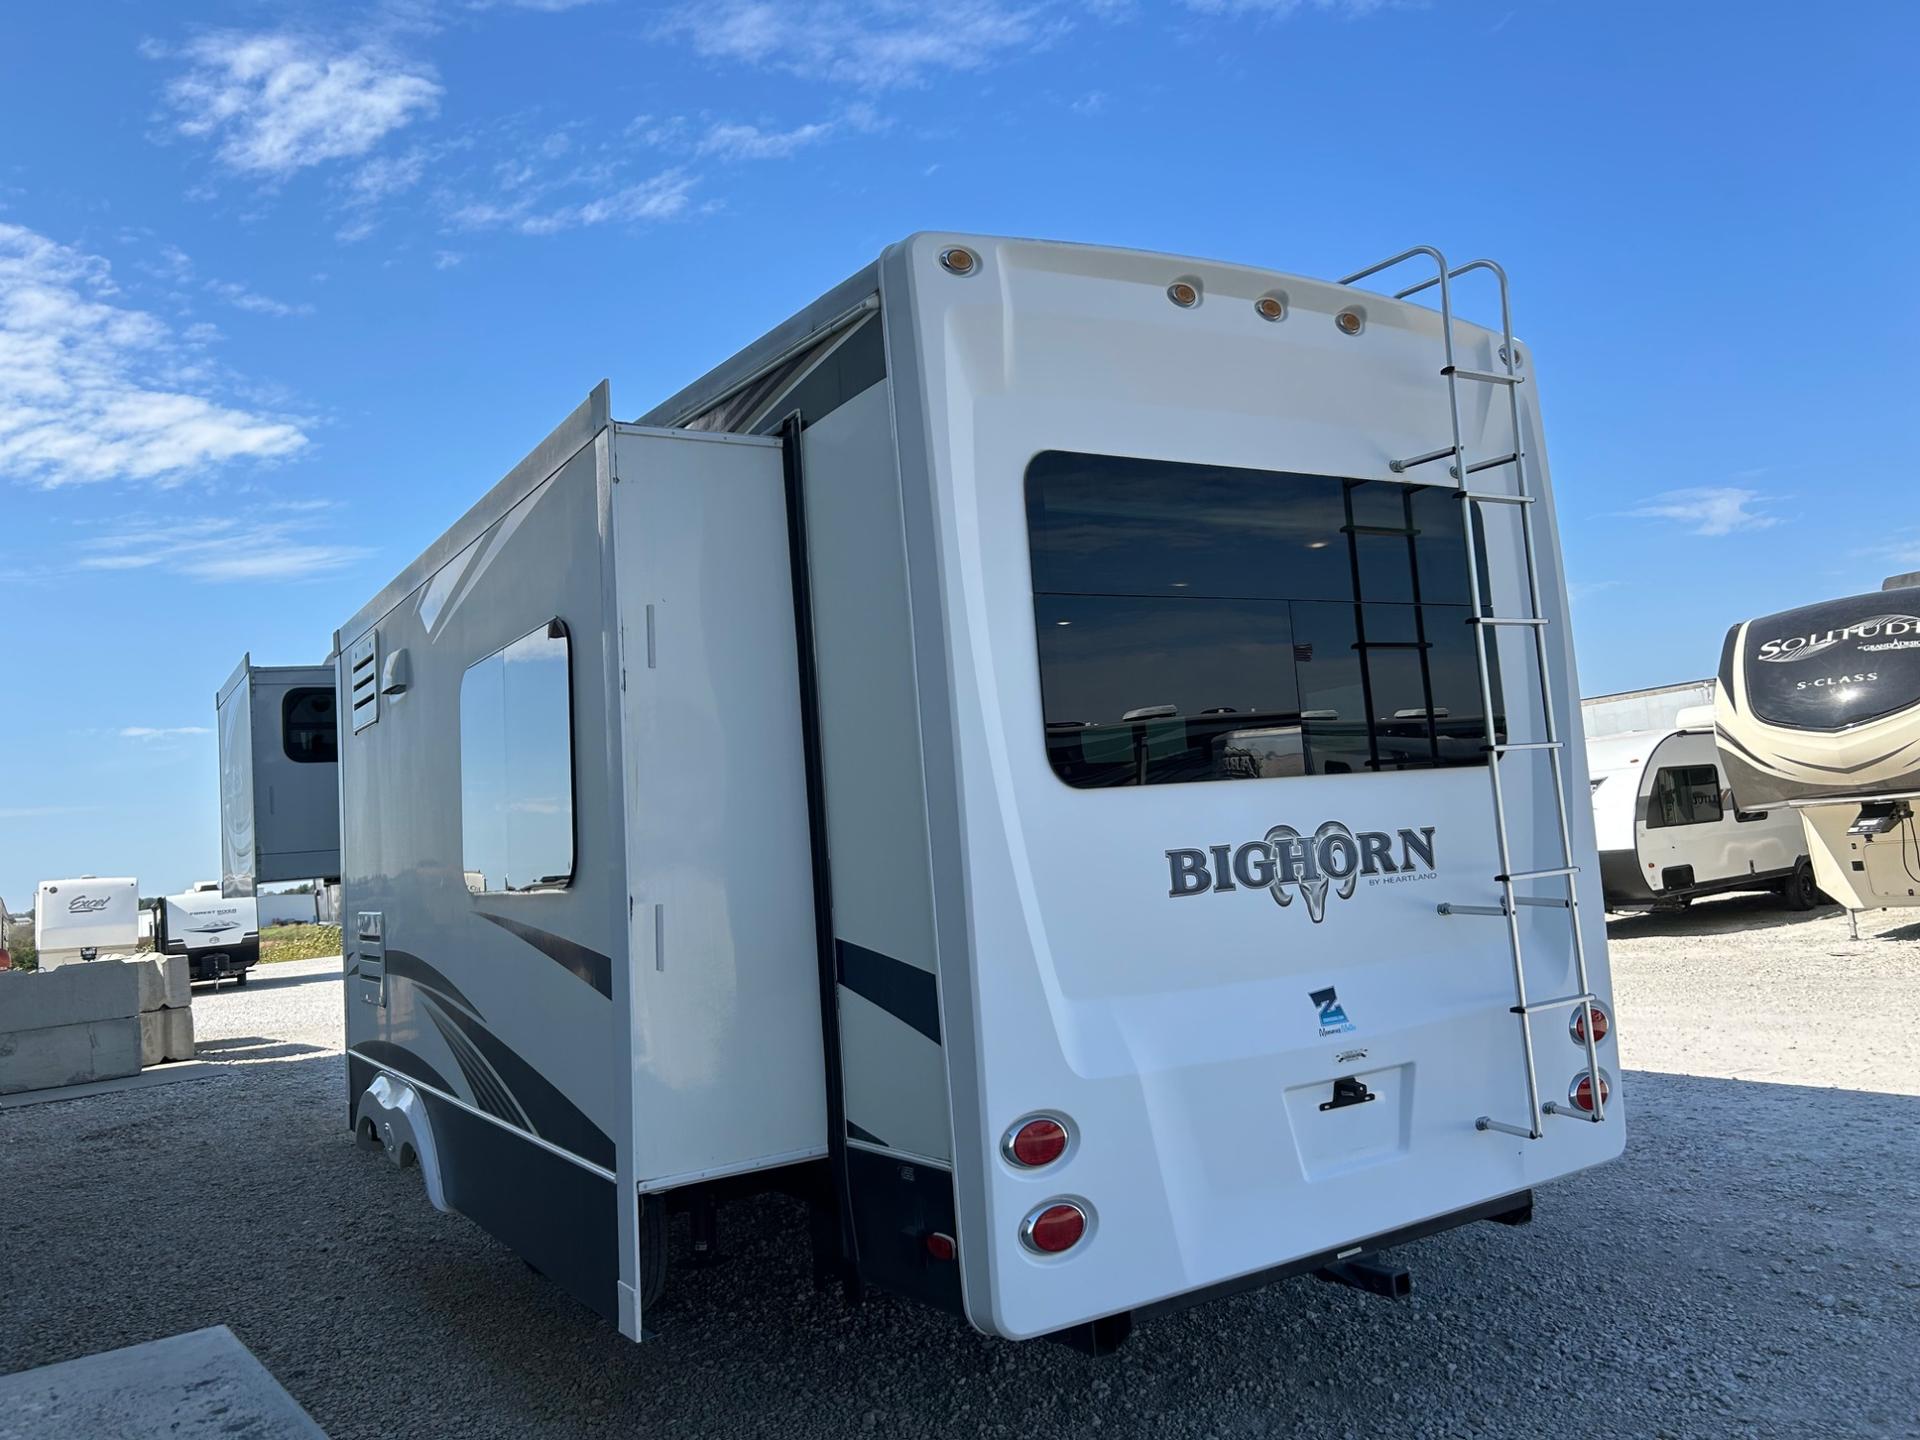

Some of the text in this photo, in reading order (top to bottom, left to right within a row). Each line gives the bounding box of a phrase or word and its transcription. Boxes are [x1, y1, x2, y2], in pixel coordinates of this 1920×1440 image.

[1863, 642, 1894, 651] GRAND
[1797, 672, 1878, 690] S-CLASS
[1165, 826, 1436, 898] BIGHORN
[1383, 872, 1437, 884] HEARTLAND
[69, 895, 111, 911] Excel
